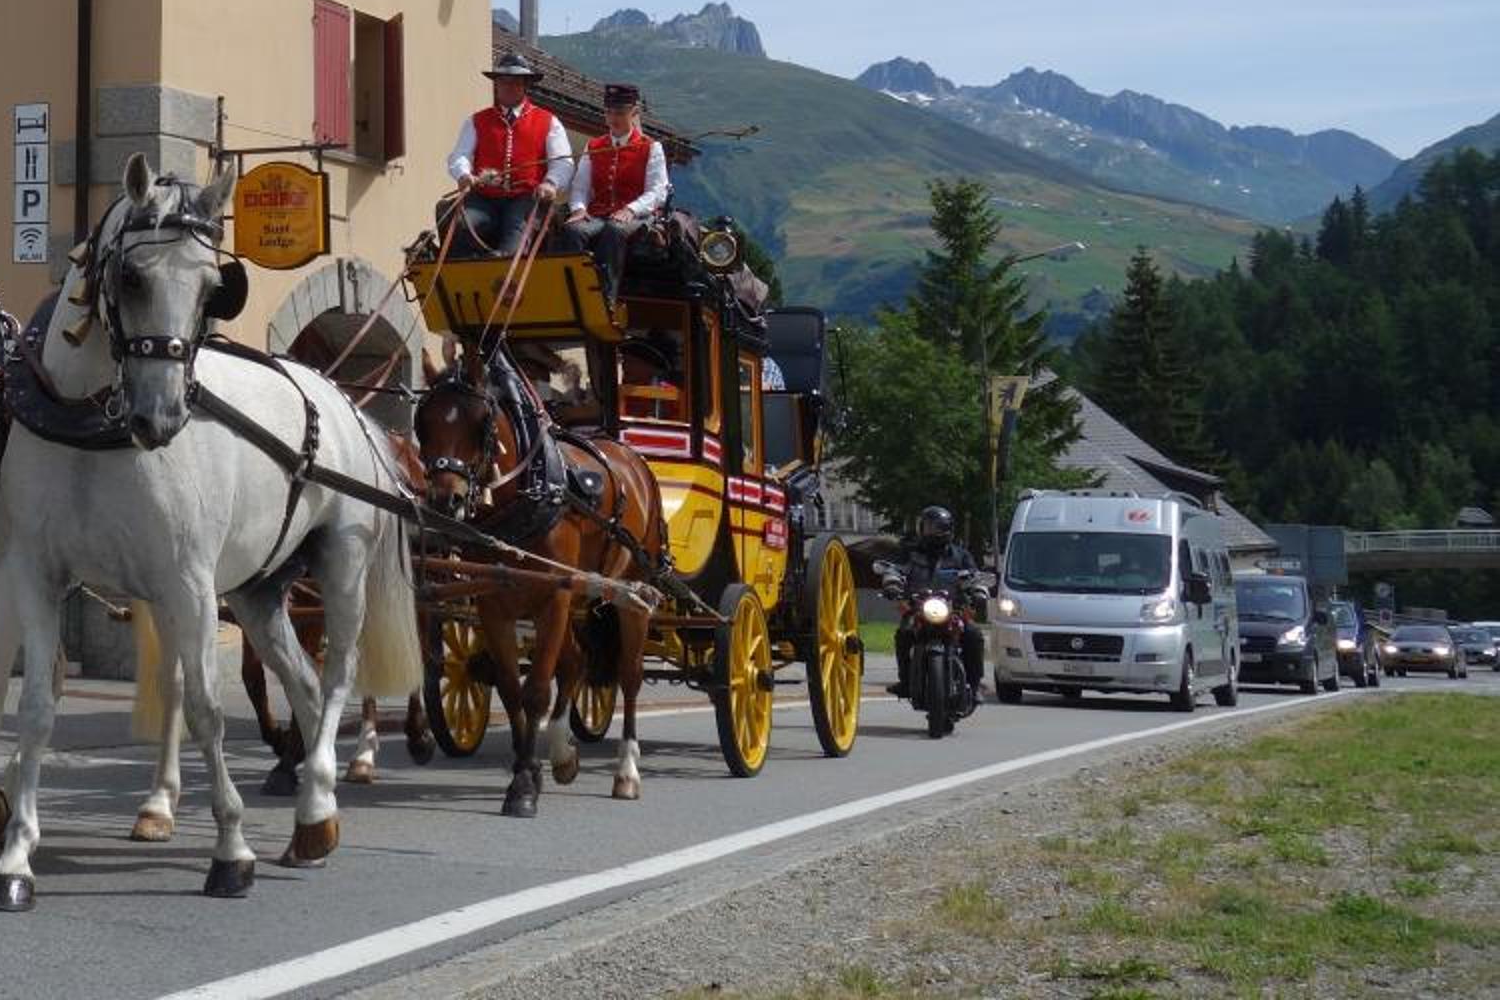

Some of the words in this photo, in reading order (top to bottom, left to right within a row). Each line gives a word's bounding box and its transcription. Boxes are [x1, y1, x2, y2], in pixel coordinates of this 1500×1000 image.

[23, 189, 41, 217] P
[263, 224, 290, 233] Sust
[259, 236, 293, 248] Lodge
